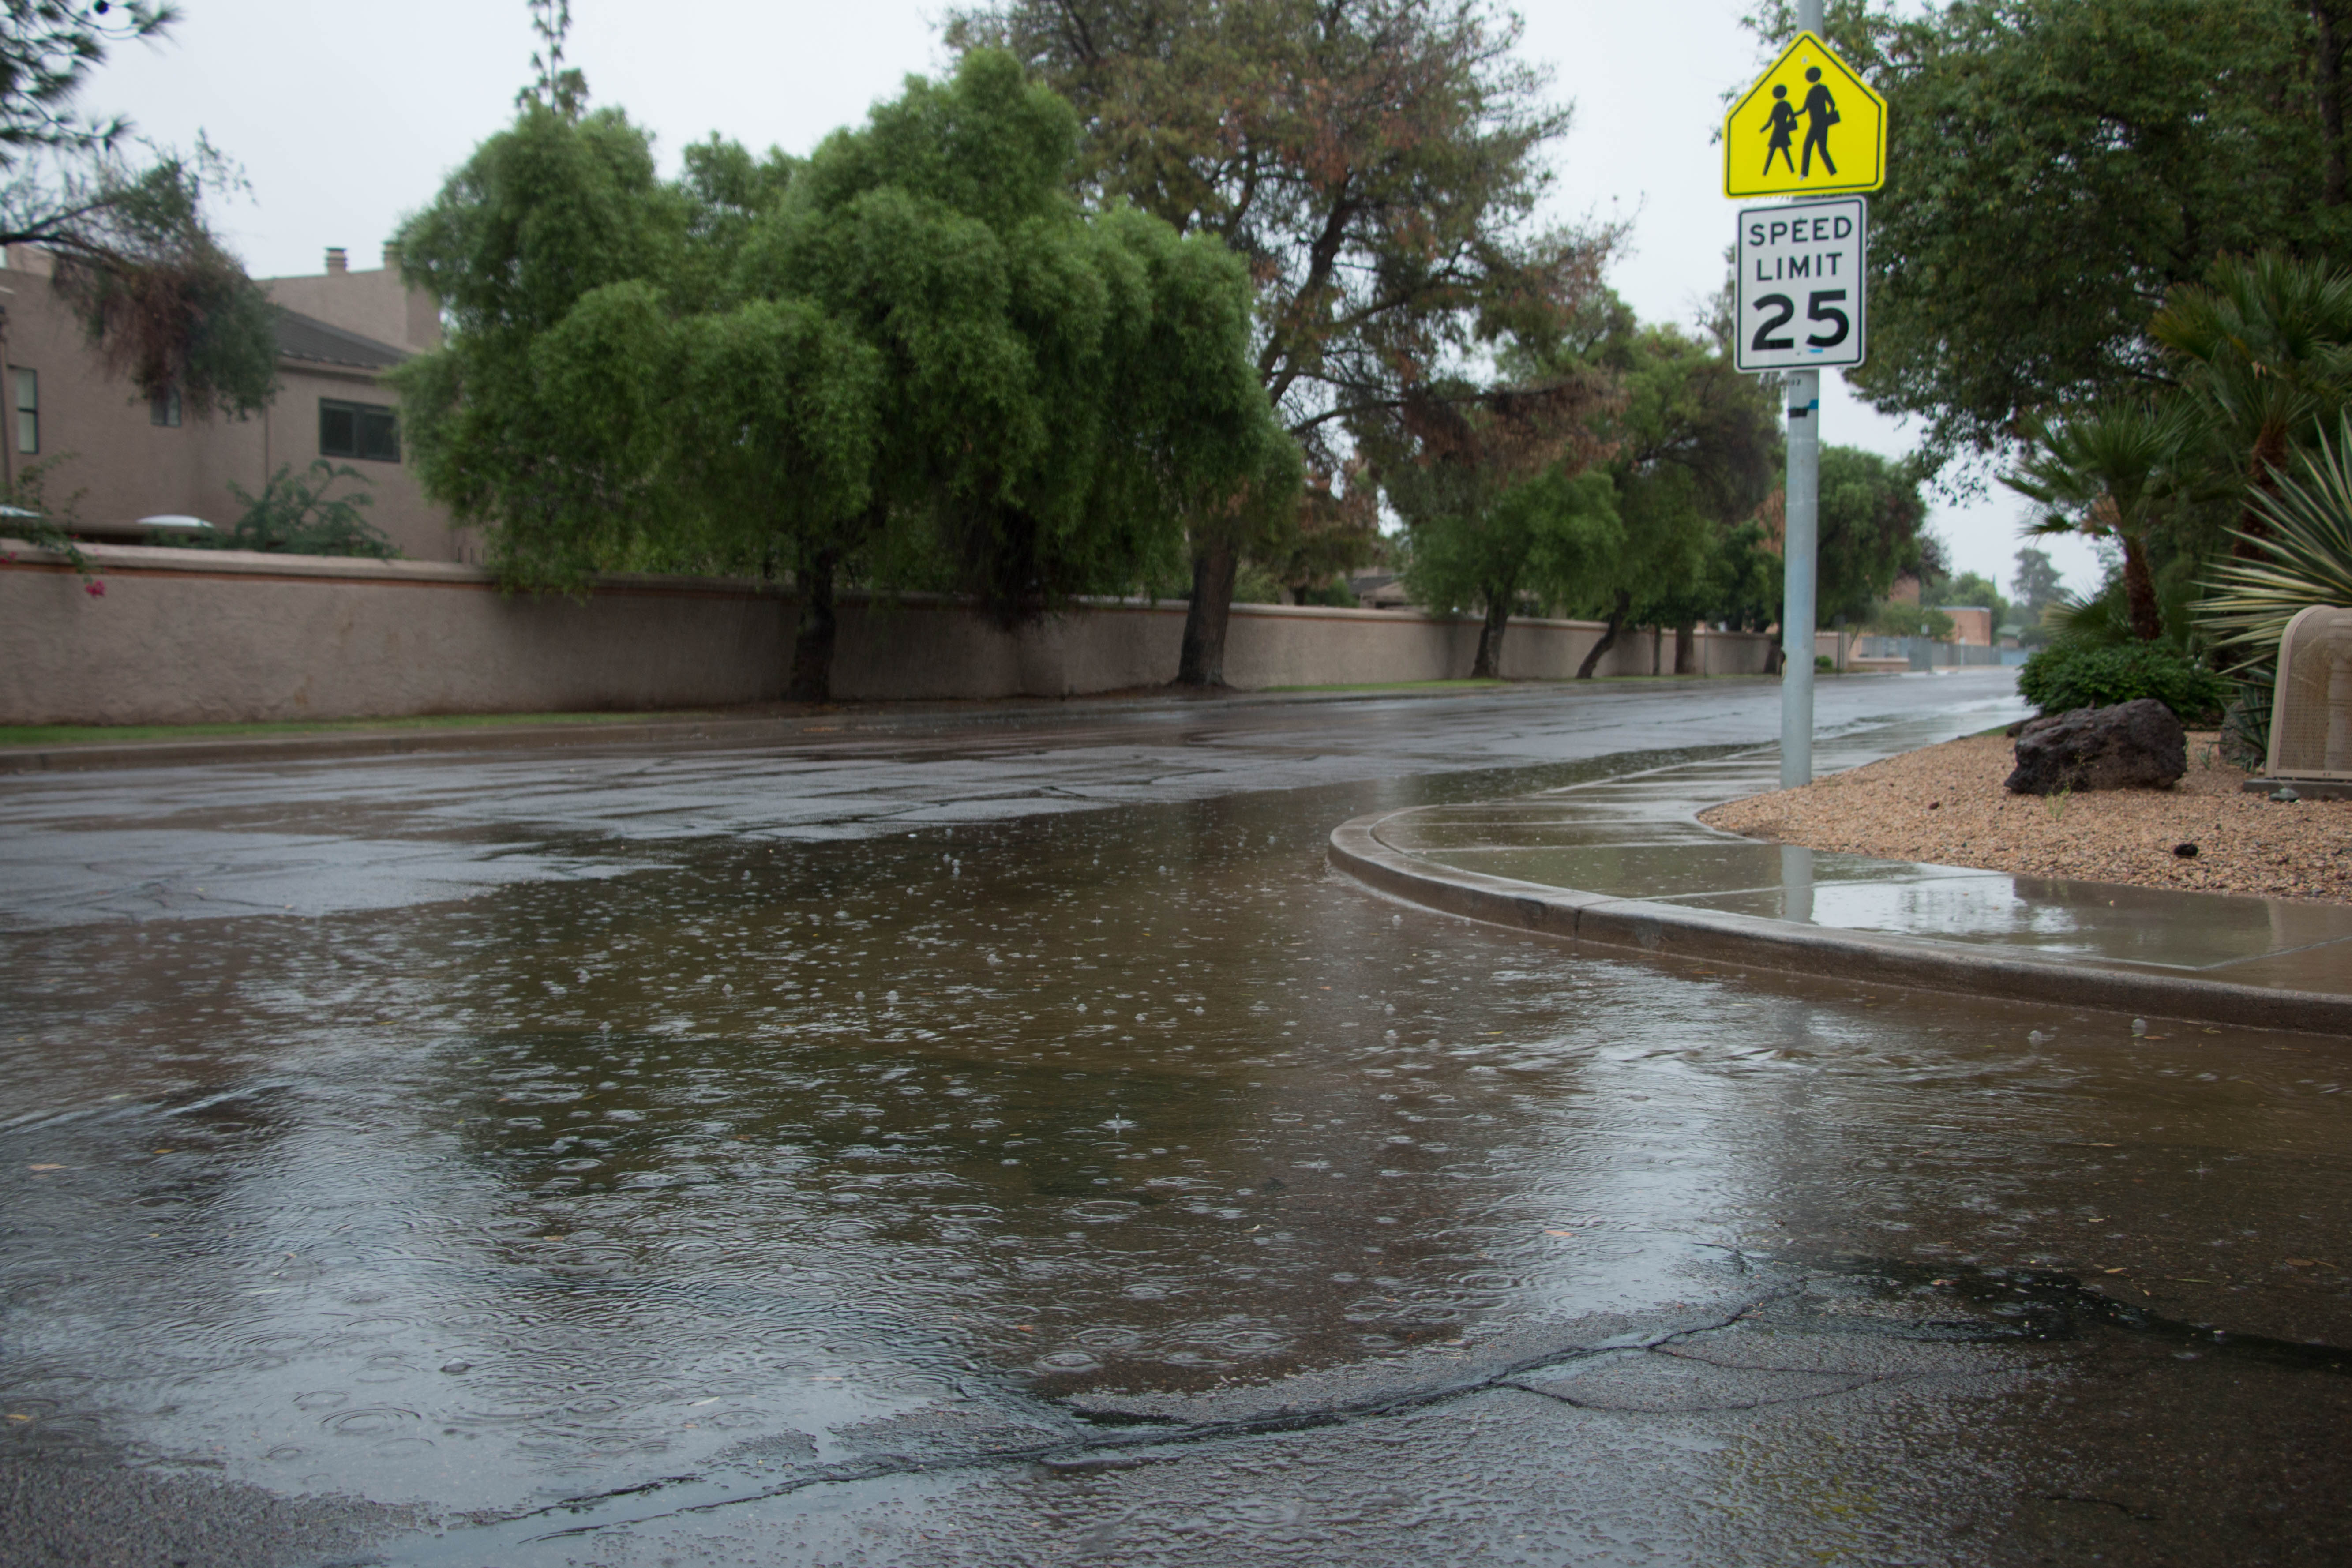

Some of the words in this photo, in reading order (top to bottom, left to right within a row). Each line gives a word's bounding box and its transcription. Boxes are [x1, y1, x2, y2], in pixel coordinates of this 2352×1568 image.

[1749, 217, 1852, 246] SPEED
[1757, 253, 1842, 281] LIMIT
[1752, 289, 1849, 351] 25
